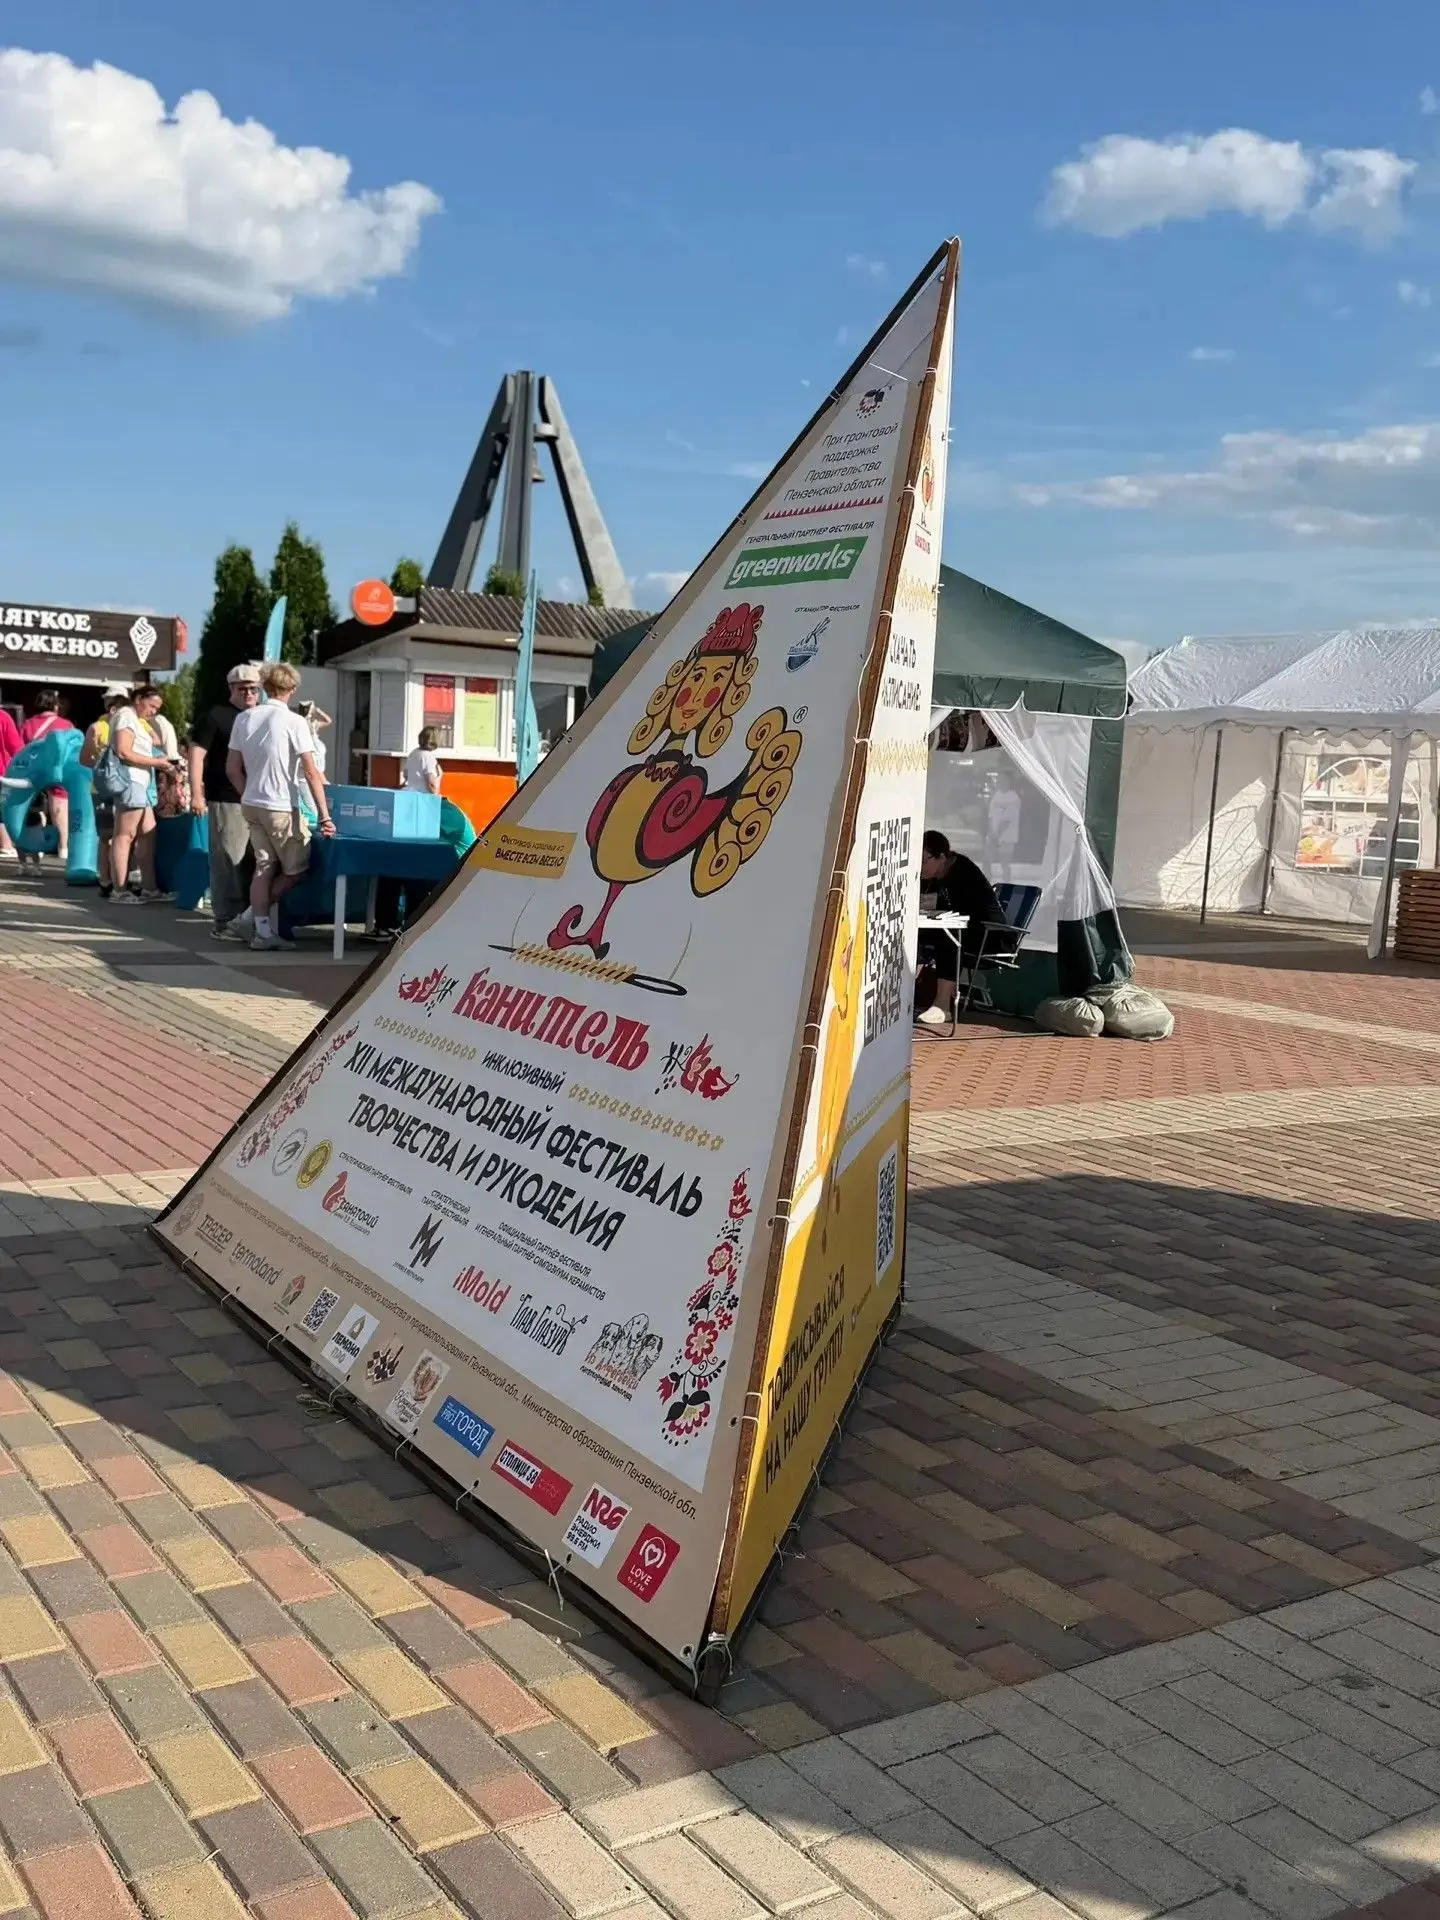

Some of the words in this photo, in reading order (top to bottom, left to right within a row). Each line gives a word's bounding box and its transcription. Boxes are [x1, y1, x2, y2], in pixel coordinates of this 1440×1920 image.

[822, 434, 842, 448] При
[843, 423, 898, 445] грантовой
[822, 445, 880, 464] поддержке
[783, 484, 843, 501] Пензенской
[843, 477, 887, 492] области
[829, 521, 875, 534] ФЕСТИВАЛЯ
[729, 544, 855, 585] greenworks
[481, 1050, 567, 1094] ИНКЛЮЗИВНЫЙ
[343, 1041, 377, 1075] XII
[366, 1051, 553, 1150] МЕЖДУНАРОДНЫЙ
[546, 1124, 703, 1218] ФЕСТИВАЛЬ
[348, 1093, 461, 1172] ТВОРЧЕСТВА
[456, 1144, 486, 1181] И
[474, 1153, 626, 1252] РУКОДЕЛИЯ
[478, 1225, 514, 1249] ГЕНЕРАЛЬНЫЙ
[511, 1243, 535, 1261] ПАРТНЁР
[566, 1275, 606, 1301] КЕРАМИСТОВ
[498, 1222, 538, 1249] ОФИЦИАЛЬНЫЙ
[535, 1241, 560, 1259] ПАРТНЁР
[559, 1254, 591, 1277] ФЕСТИВАЛЯ
[453, 1265, 512, 1314] iMold
[767, 1264, 845, 1424] ПОДПИСЫВАЙСЯ
[765, 1438, 782, 1493] НА
[783, 1373, 813, 1457] НАШУ
[813, 1314, 845, 1404] ГРУППУ
[451, 1410, 489, 1450] ГОРОД
[467, 1356, 507, 1388] Пензенской
[521, 1393, 573, 1435] Министерство
[572, 1430, 624, 1469] образования
[622, 1461, 678, 1505] Пензенской
[676, 1499, 697, 1520] обл.
[500, 1450, 530, 1478] СТОЛИЦА
[526, 1468, 538, 1484] 58
[570, 1523, 601, 1549] ЭНЕРДЖИ
[575, 1515, 597, 1535] РАДИО
[630, 1565, 652, 1586] LOVE
